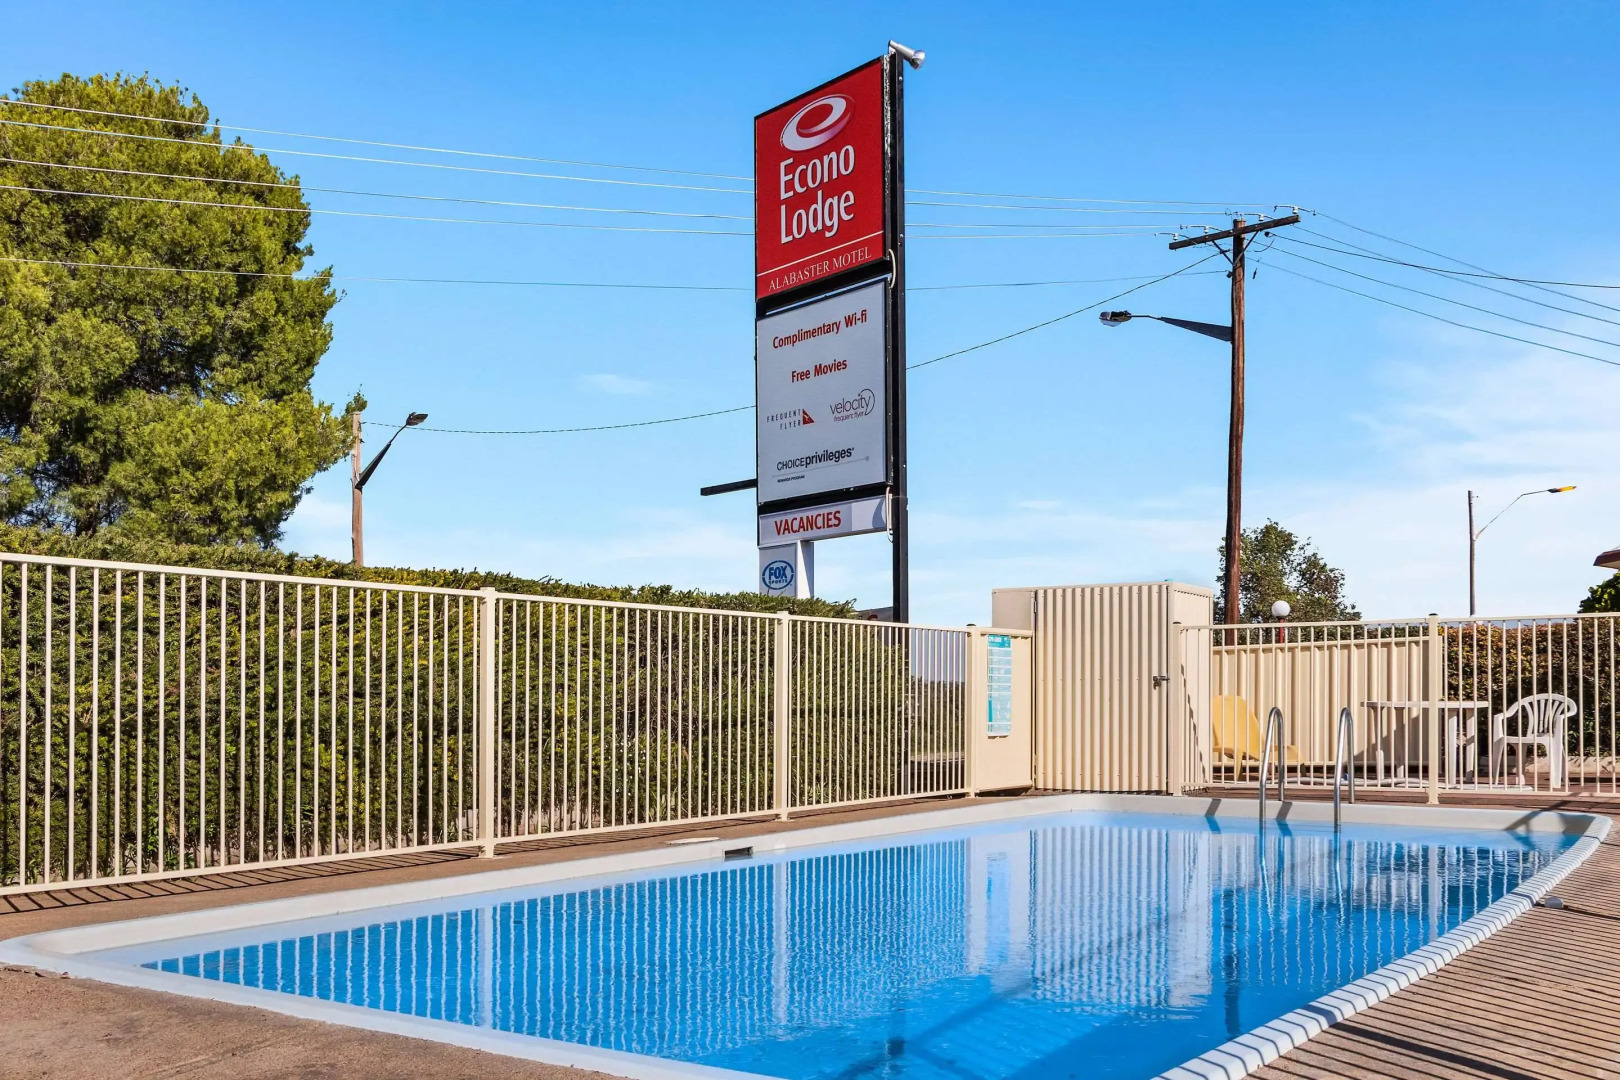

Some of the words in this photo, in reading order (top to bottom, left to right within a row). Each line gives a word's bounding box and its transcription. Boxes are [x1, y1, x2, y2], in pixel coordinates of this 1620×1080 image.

[780, 145, 855, 200] Econo
[781, 190, 855, 244] Lodge
[769, 261, 830, 292] ALABASTER
[833, 247, 872, 270] MOTEL
[773, 320, 841, 349] Complimentary
[844, 309, 867, 328] Wi-fi
[791, 370, 811, 383] Free
[814, 359, 848, 377] Movies
[830, 391, 872, 415] velocity
[766, 409, 801, 423] FREQUENT
[780, 419, 801, 430] FLYER
[774, 510, 842, 536] VACANCIES
[768, 565, 788, 580] FOX
